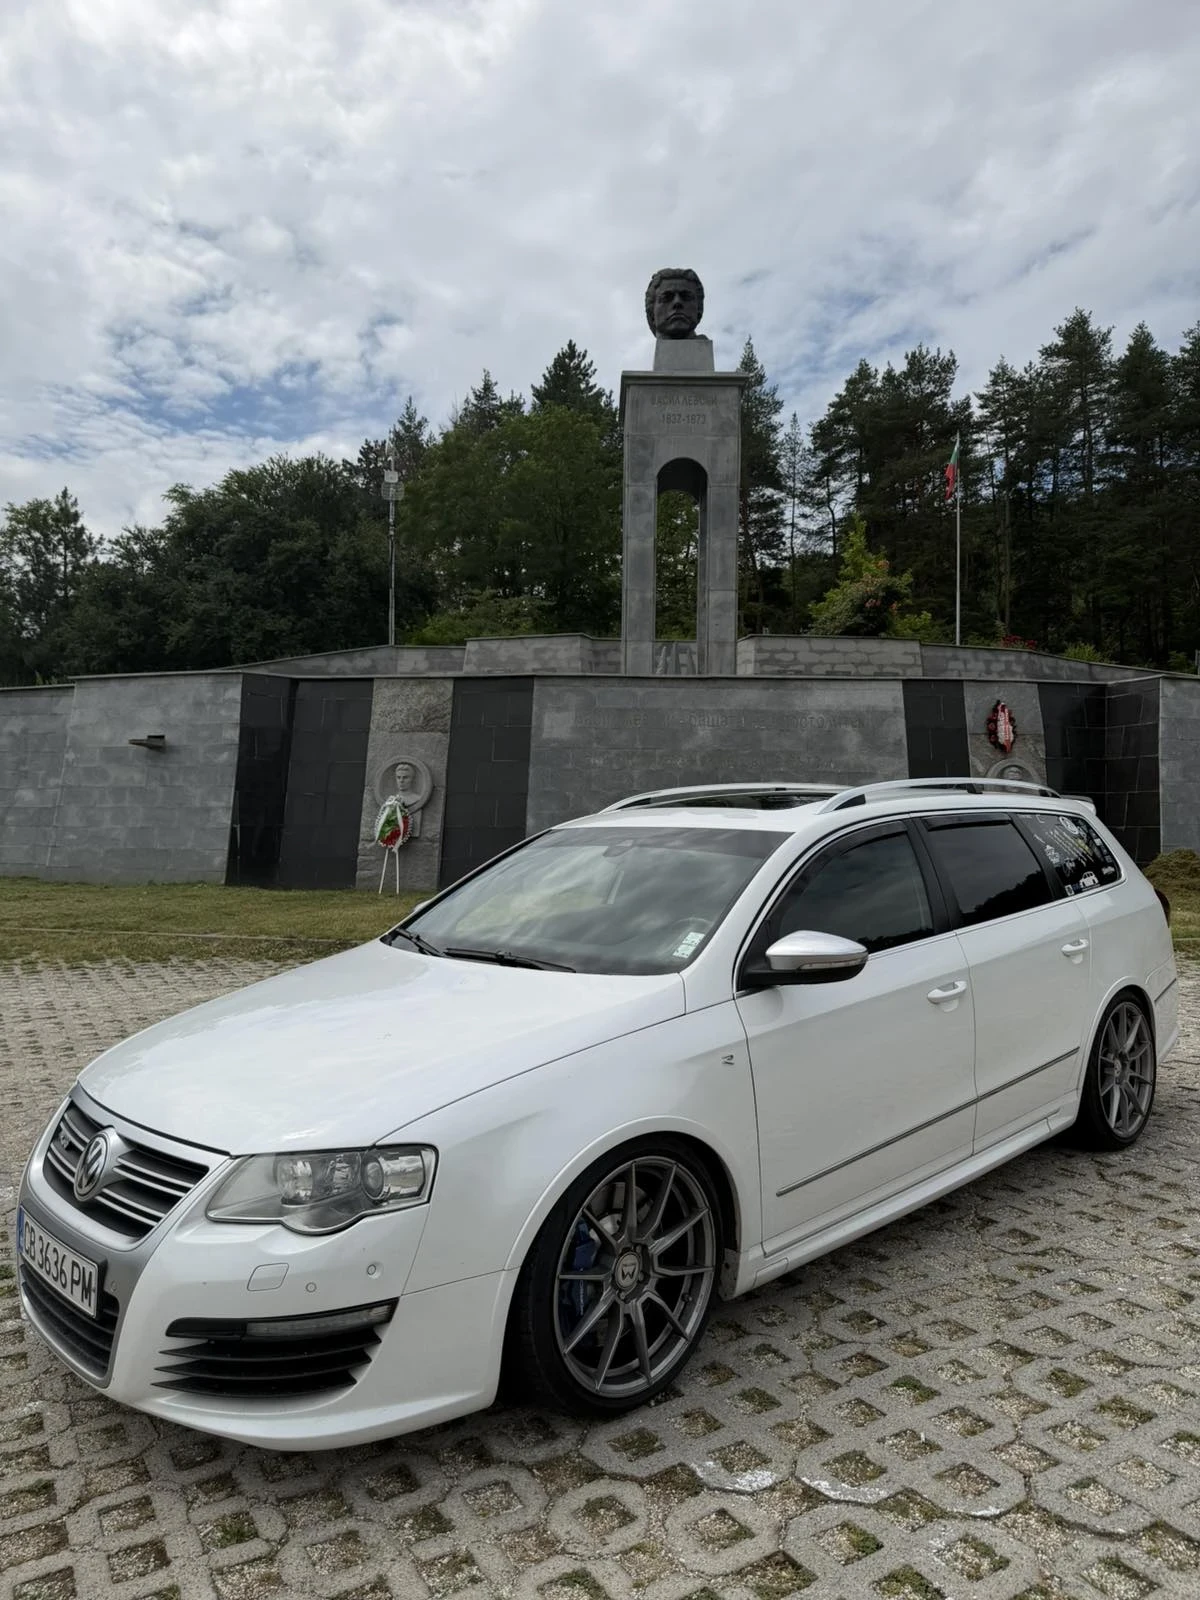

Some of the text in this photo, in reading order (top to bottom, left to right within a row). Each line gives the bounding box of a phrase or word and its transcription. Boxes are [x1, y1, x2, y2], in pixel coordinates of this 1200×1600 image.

[24, 1220, 93, 1308] CB 3636 PM
